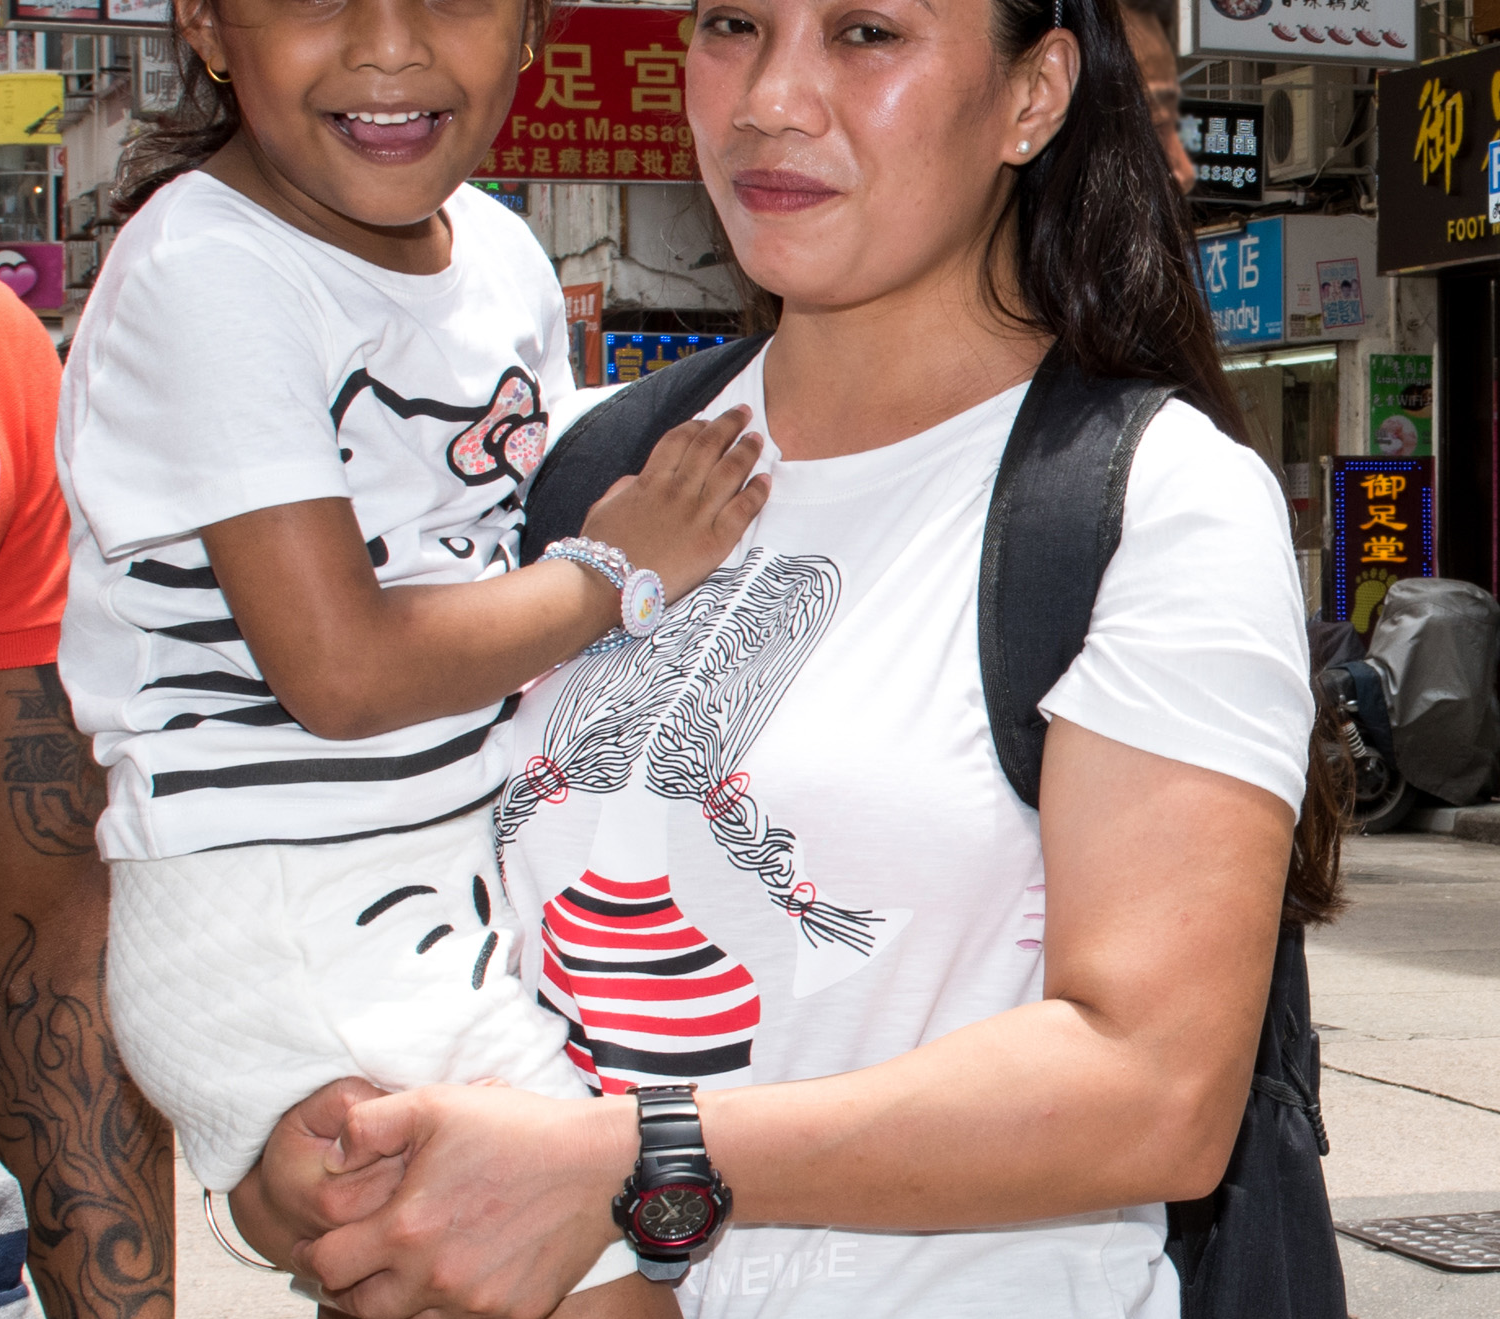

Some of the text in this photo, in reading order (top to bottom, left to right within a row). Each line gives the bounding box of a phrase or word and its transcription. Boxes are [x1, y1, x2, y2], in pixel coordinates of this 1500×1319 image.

[511, 116, 693, 147] Foot Massag
[1447, 214, 1487, 242] FOOT
[1359, 473, 1408, 563] 御足堂
